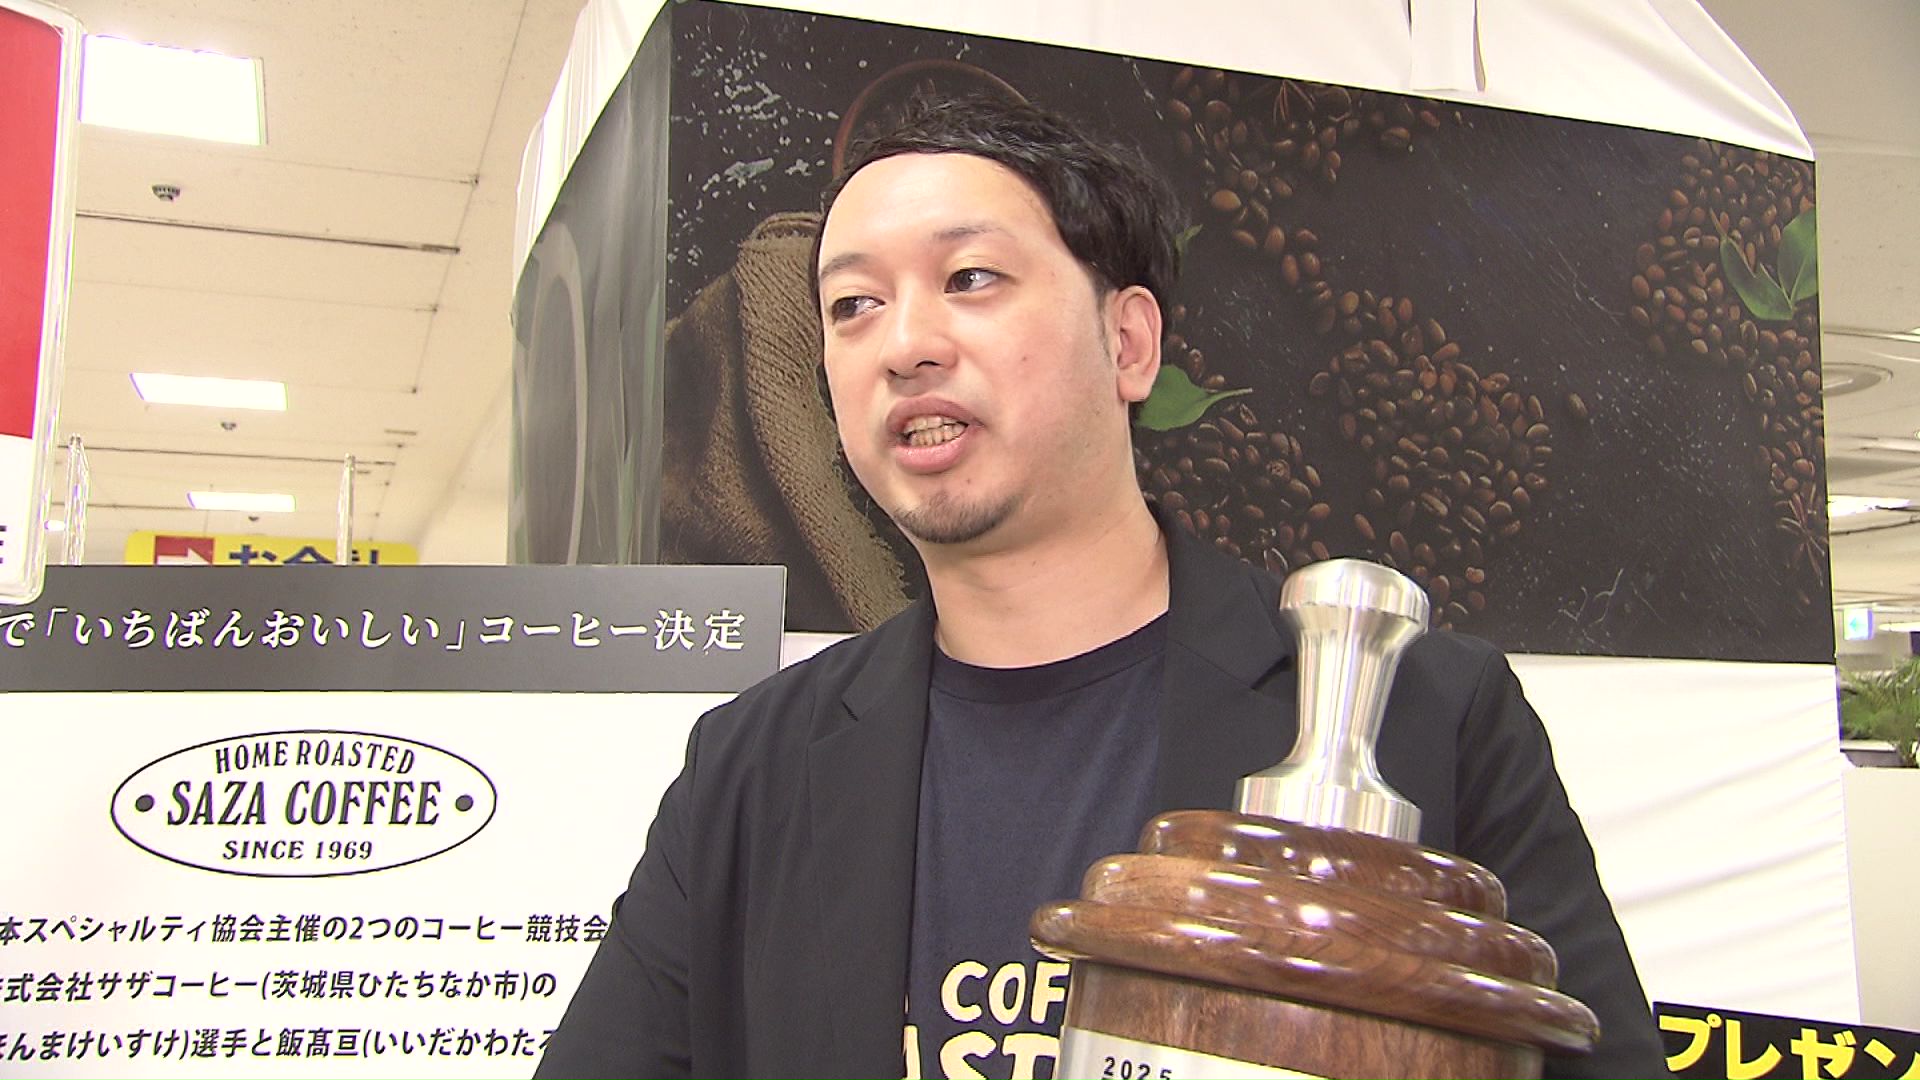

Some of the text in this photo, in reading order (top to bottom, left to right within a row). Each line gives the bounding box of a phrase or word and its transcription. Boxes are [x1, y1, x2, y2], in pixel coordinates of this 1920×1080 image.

[215, 739, 415, 774] HOME ROASTED
[167, 780, 441, 826] SAZA COFFEE
[222, 840, 373, 860] SINCE 1969
[0, 970, 557, 1003] 式会社サザコーヒー(茨城県ひたちなか市)の
